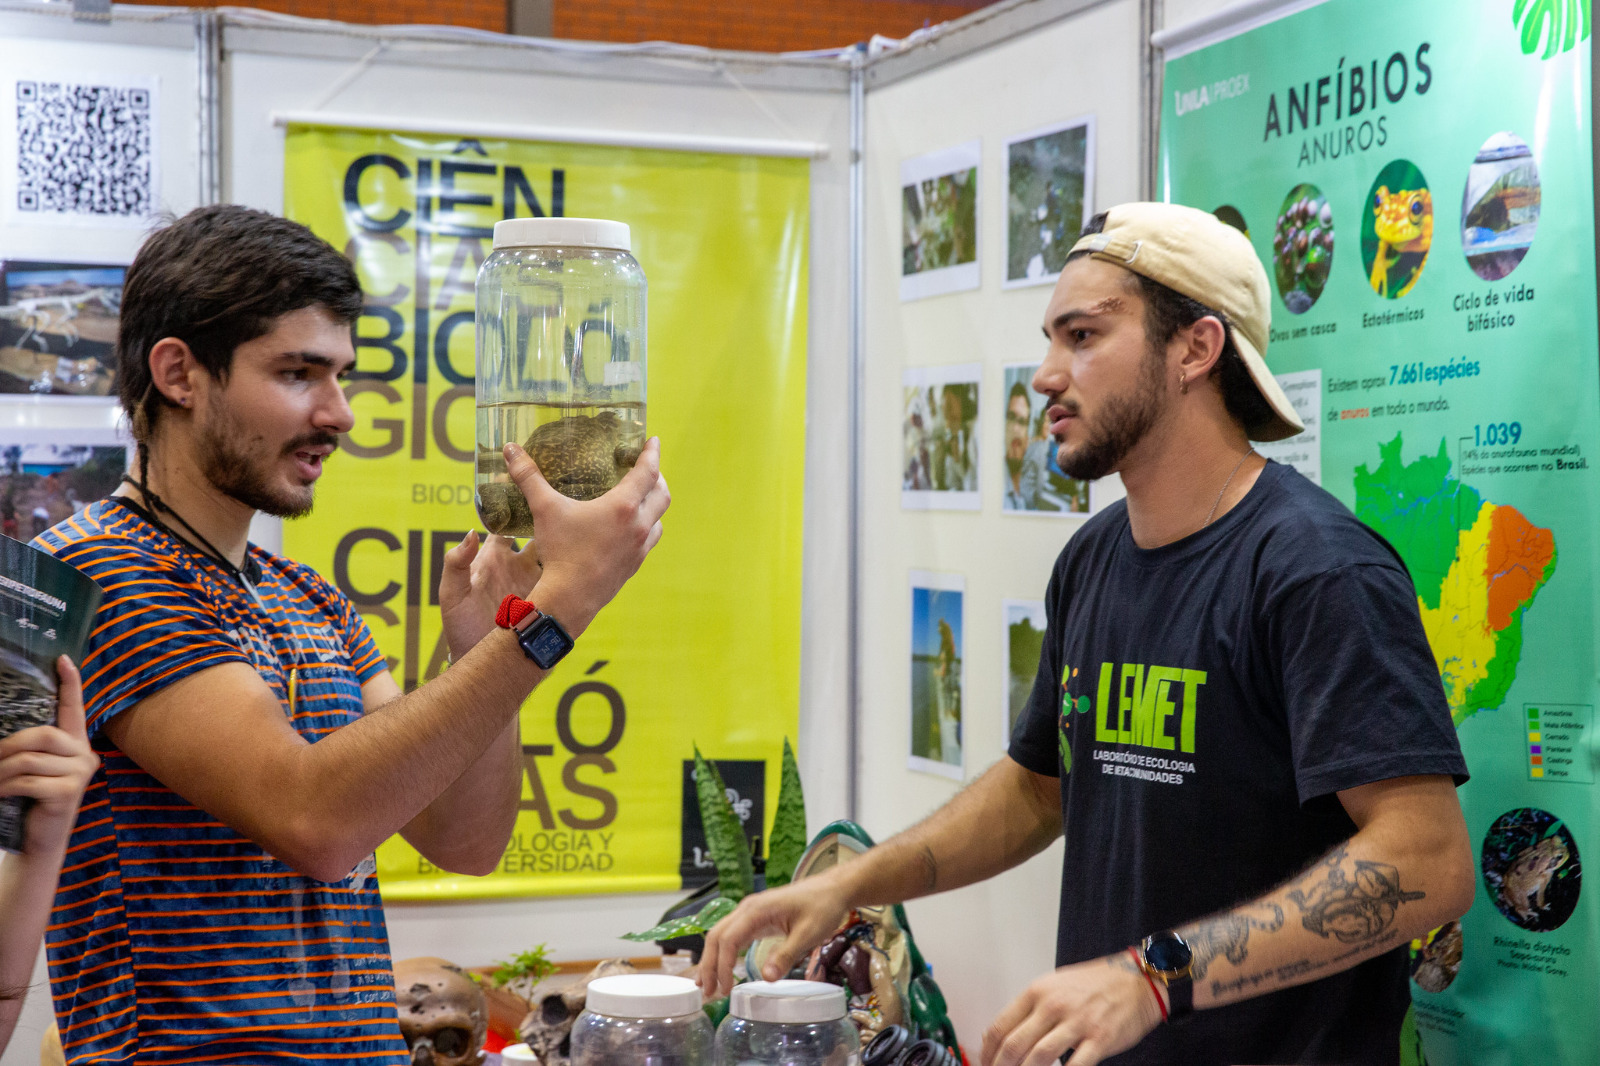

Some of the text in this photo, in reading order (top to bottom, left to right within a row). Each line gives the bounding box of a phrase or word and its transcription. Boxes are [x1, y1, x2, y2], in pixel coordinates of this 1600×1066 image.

[1264, 42, 1432, 142] ANFÍBIOS
[1297, 116, 1388, 168] ANUROS
[1453, 284, 1535, 312] Ciclo de vida
[1362, 308, 1424, 328] Ectotérmicos
[1467, 310, 1515, 332] bifásico
[1328, 378, 1358, 393] Existem
[1327, 407, 1338, 421] de
[1340, 408, 1369, 420] anuros
[1371, 406, 1385, 417] em
[1386, 401, 1407, 415] todo
[1408, 404, 1415, 414] o
[1474, 421, 1522, 447] 1.039
[1096, 662, 1207, 753] LEMET
[1102, 763, 1114, 775] DE
[1145, 756, 1196, 773] ECOLOGIA
[599, 832, 614, 851] Y
